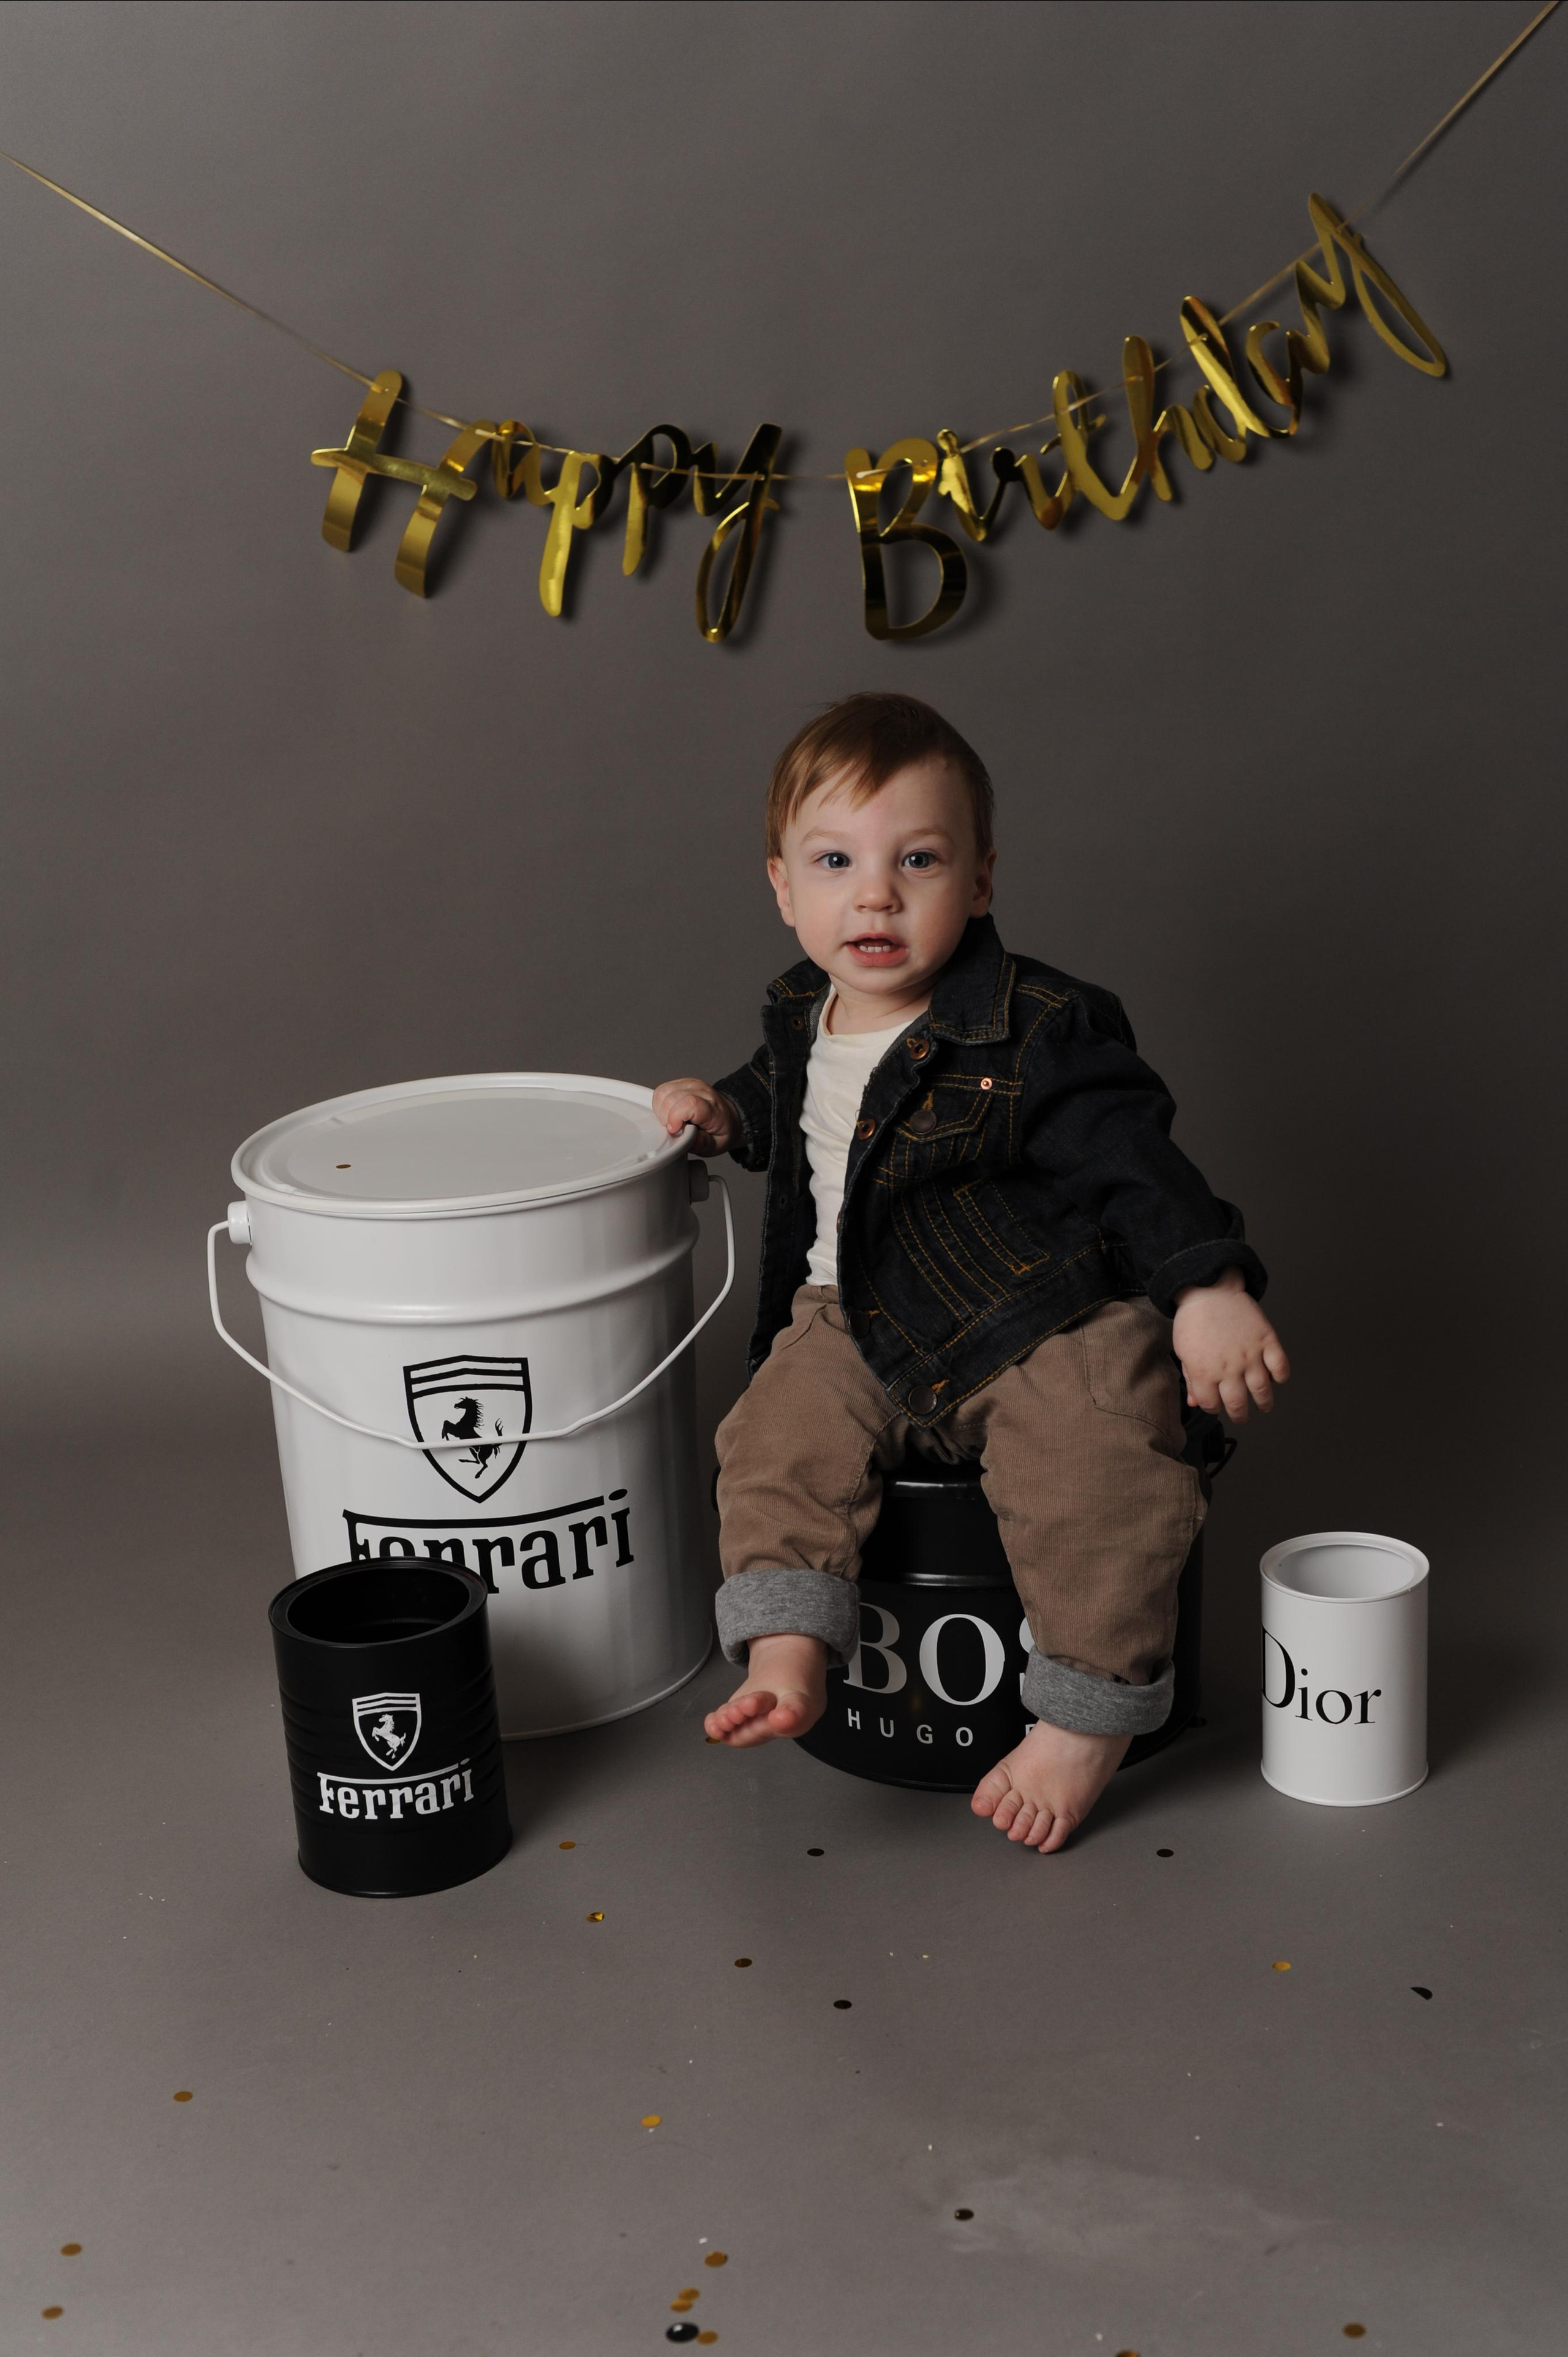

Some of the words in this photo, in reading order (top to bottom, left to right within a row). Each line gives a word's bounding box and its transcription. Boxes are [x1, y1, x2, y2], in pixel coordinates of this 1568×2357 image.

[311, 370, 782, 643] Happy
[844, 192, 1447, 641] Birthday
[843, 1601, 1038, 1706] BO
[1262, 1624, 1382, 1725] Dior
[847, 1707, 974, 1747] HUGO
[317, 1757, 474, 1820] Ferrari
